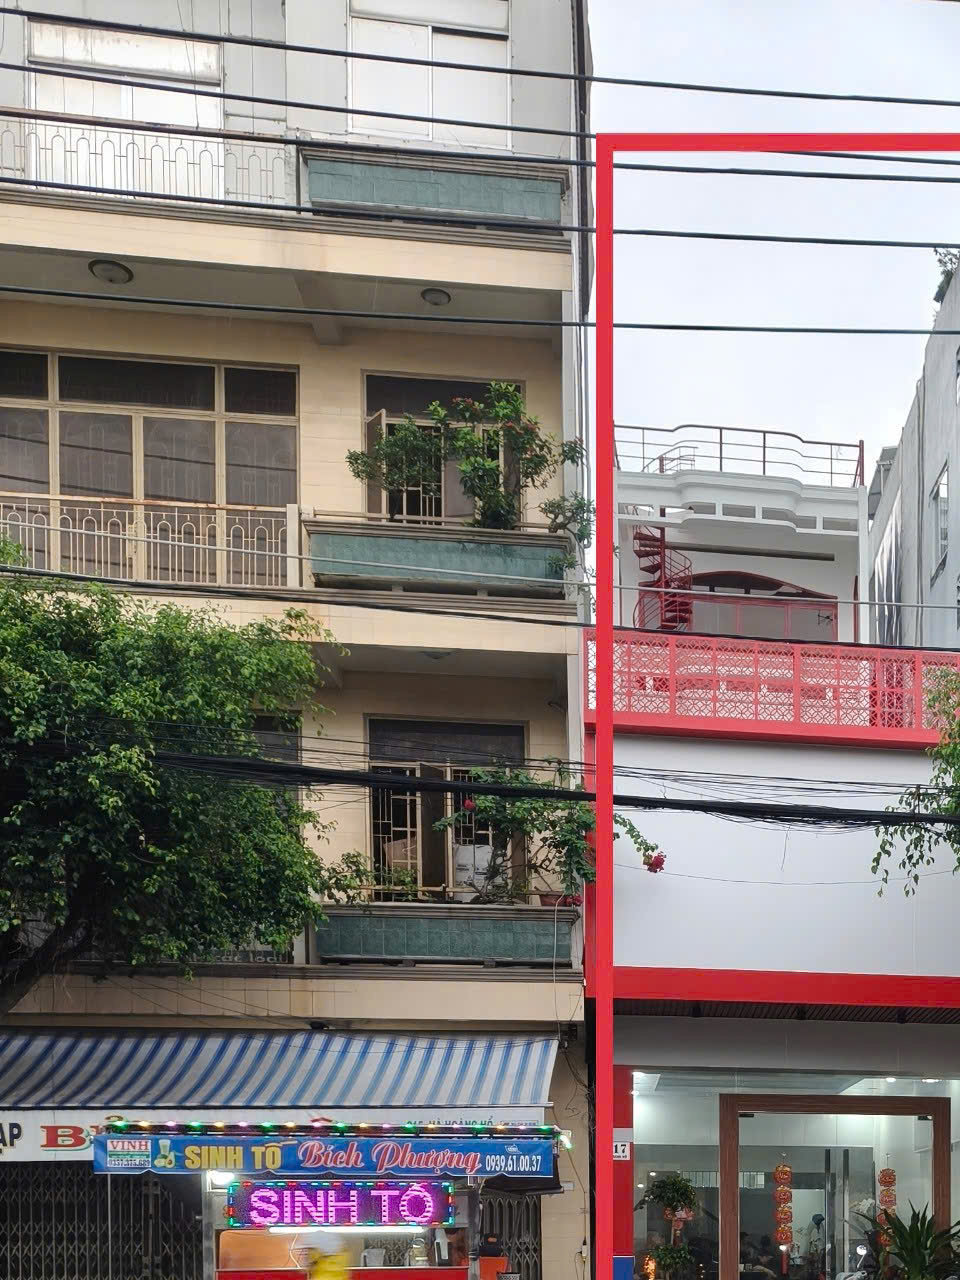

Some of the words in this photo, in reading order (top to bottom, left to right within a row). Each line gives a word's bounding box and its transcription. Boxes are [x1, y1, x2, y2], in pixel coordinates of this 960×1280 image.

[111, 1141, 149, 1151] VINH
[184, 1146, 244, 1169] SINH
[298, 1140, 365, 1168] Bích
[485, 1155, 542, 1172] 0939.61.00.37
[250, 1188, 357, 1224] SINH
